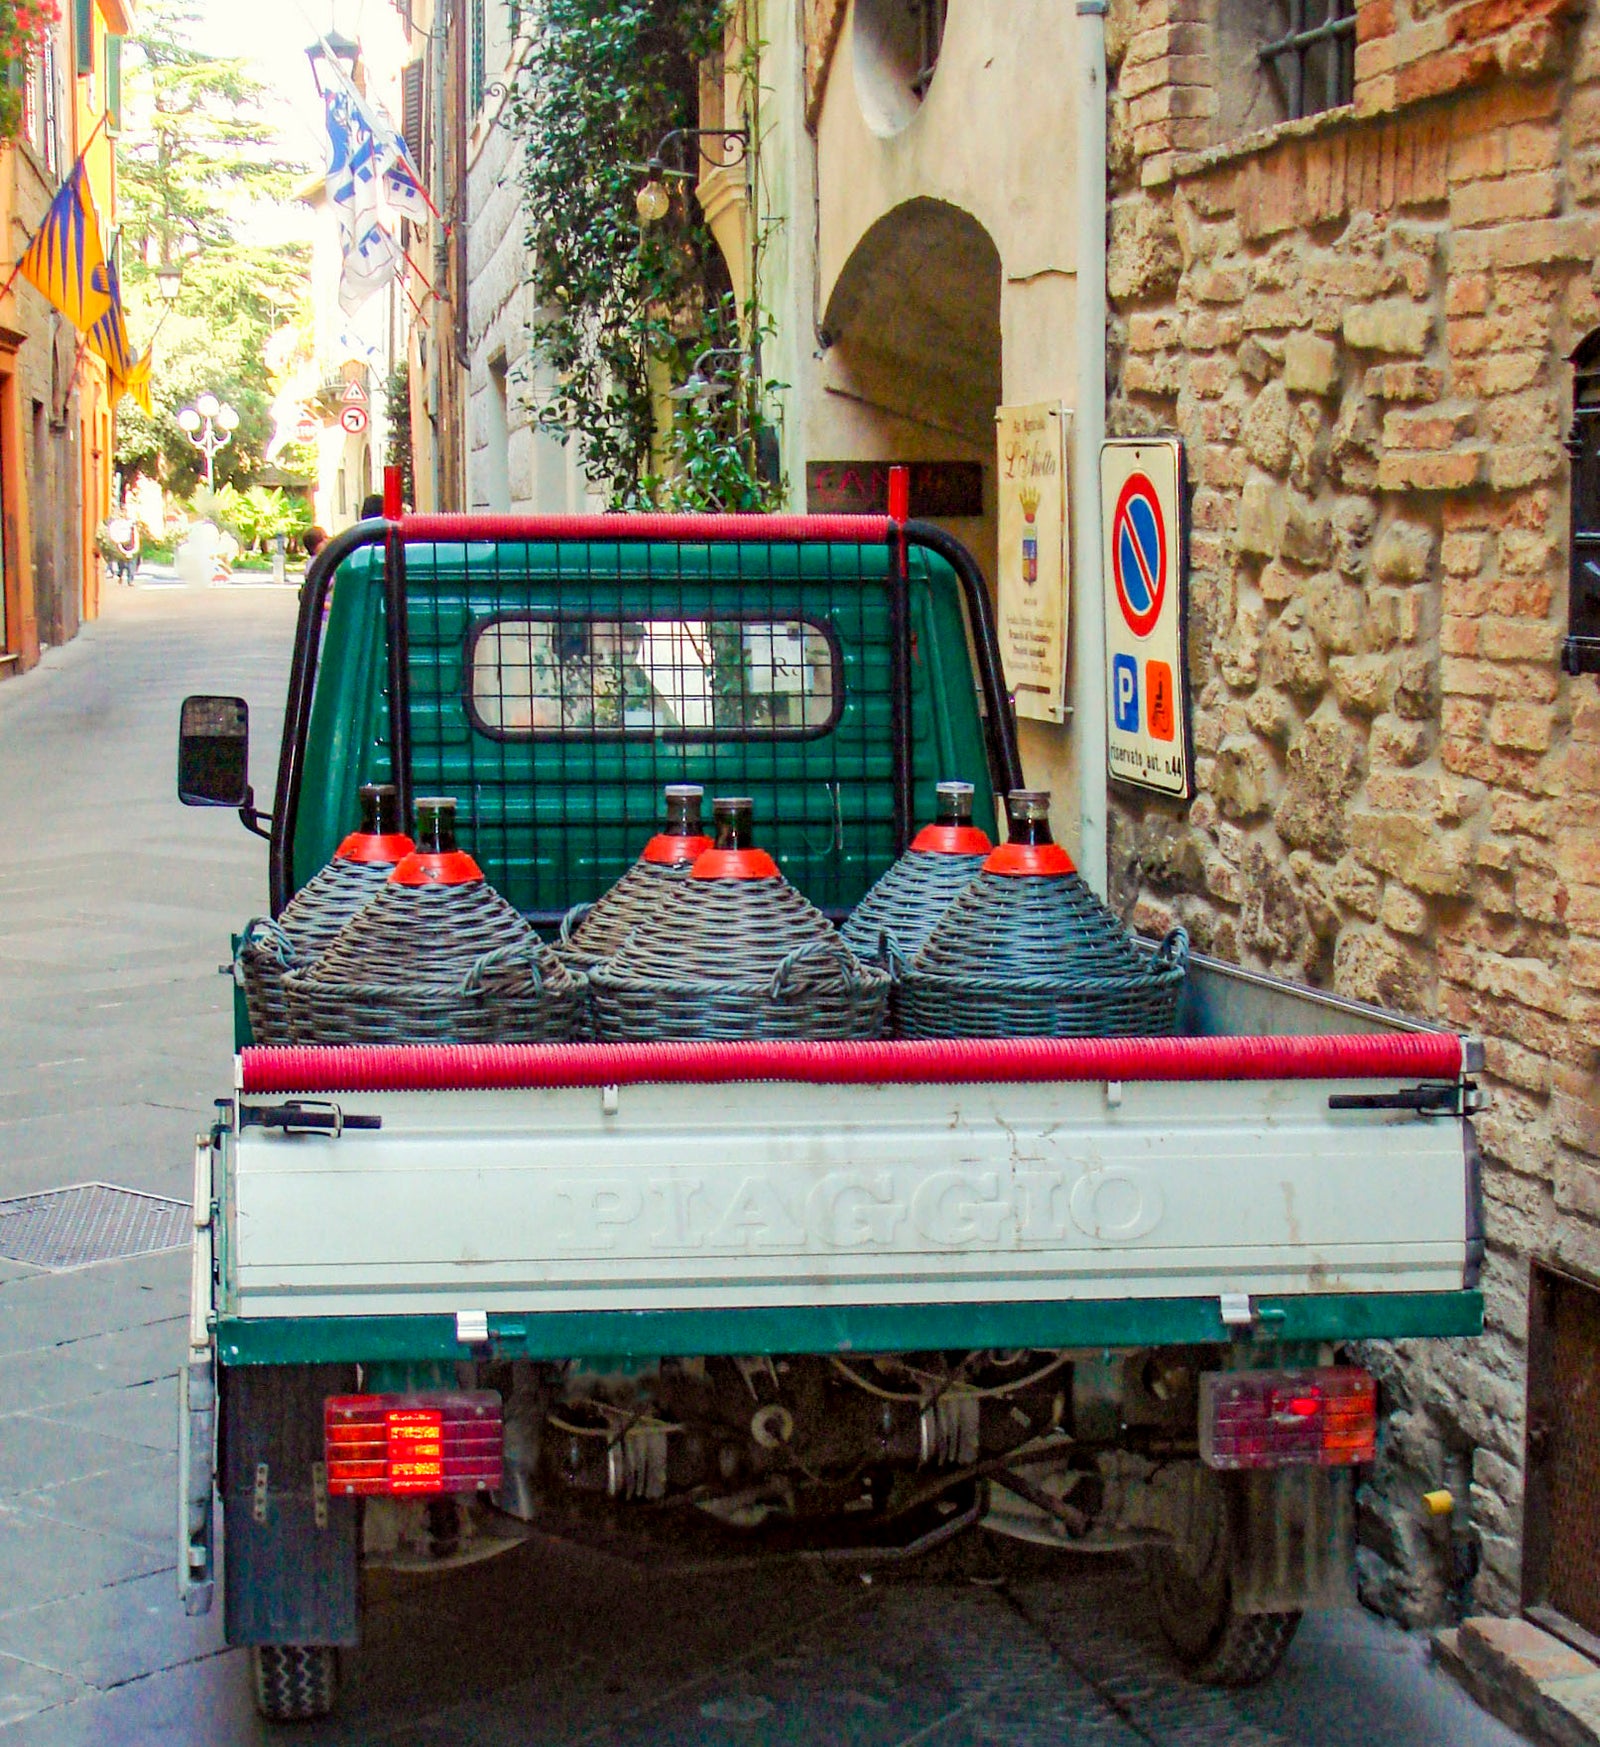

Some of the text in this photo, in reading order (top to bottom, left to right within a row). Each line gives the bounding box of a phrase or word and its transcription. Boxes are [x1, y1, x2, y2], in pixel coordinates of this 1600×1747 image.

[1118, 667, 1134, 721] P
[1110, 743, 1143, 766] riservato
[554, 1164, 1166, 1251] PIAGGIO
